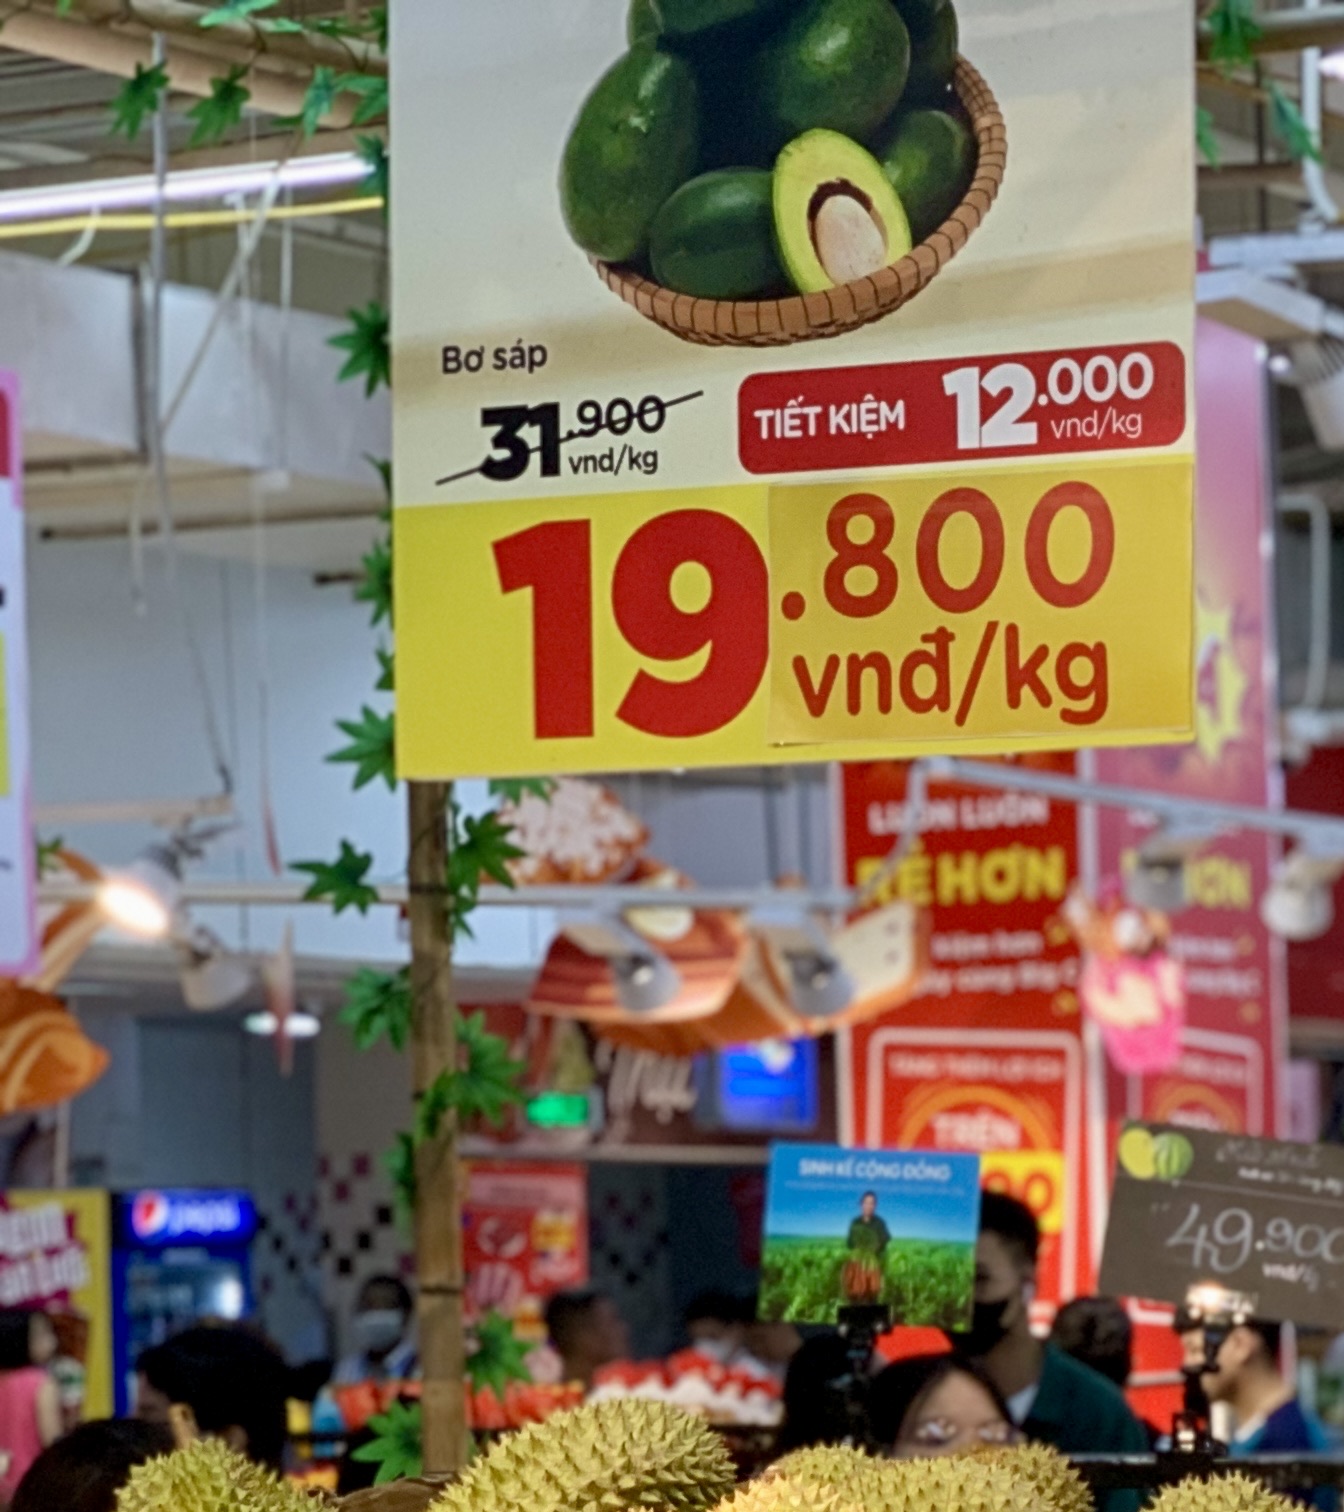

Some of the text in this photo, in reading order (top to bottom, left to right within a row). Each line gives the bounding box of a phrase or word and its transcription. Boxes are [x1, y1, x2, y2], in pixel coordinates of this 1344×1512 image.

[442, 338, 549, 374] Bơ sáp
[480, 394, 666, 482] 31.900
[754, 351, 1155, 451] TIẾT KIỆM 12.000
[1050, 406, 1143, 440] vnd/kg
[568, 443, 659, 476] vnd/kg
[491, 480, 1116, 741] 19.800
[792, 621, 1110, 727] vnđ/kg
